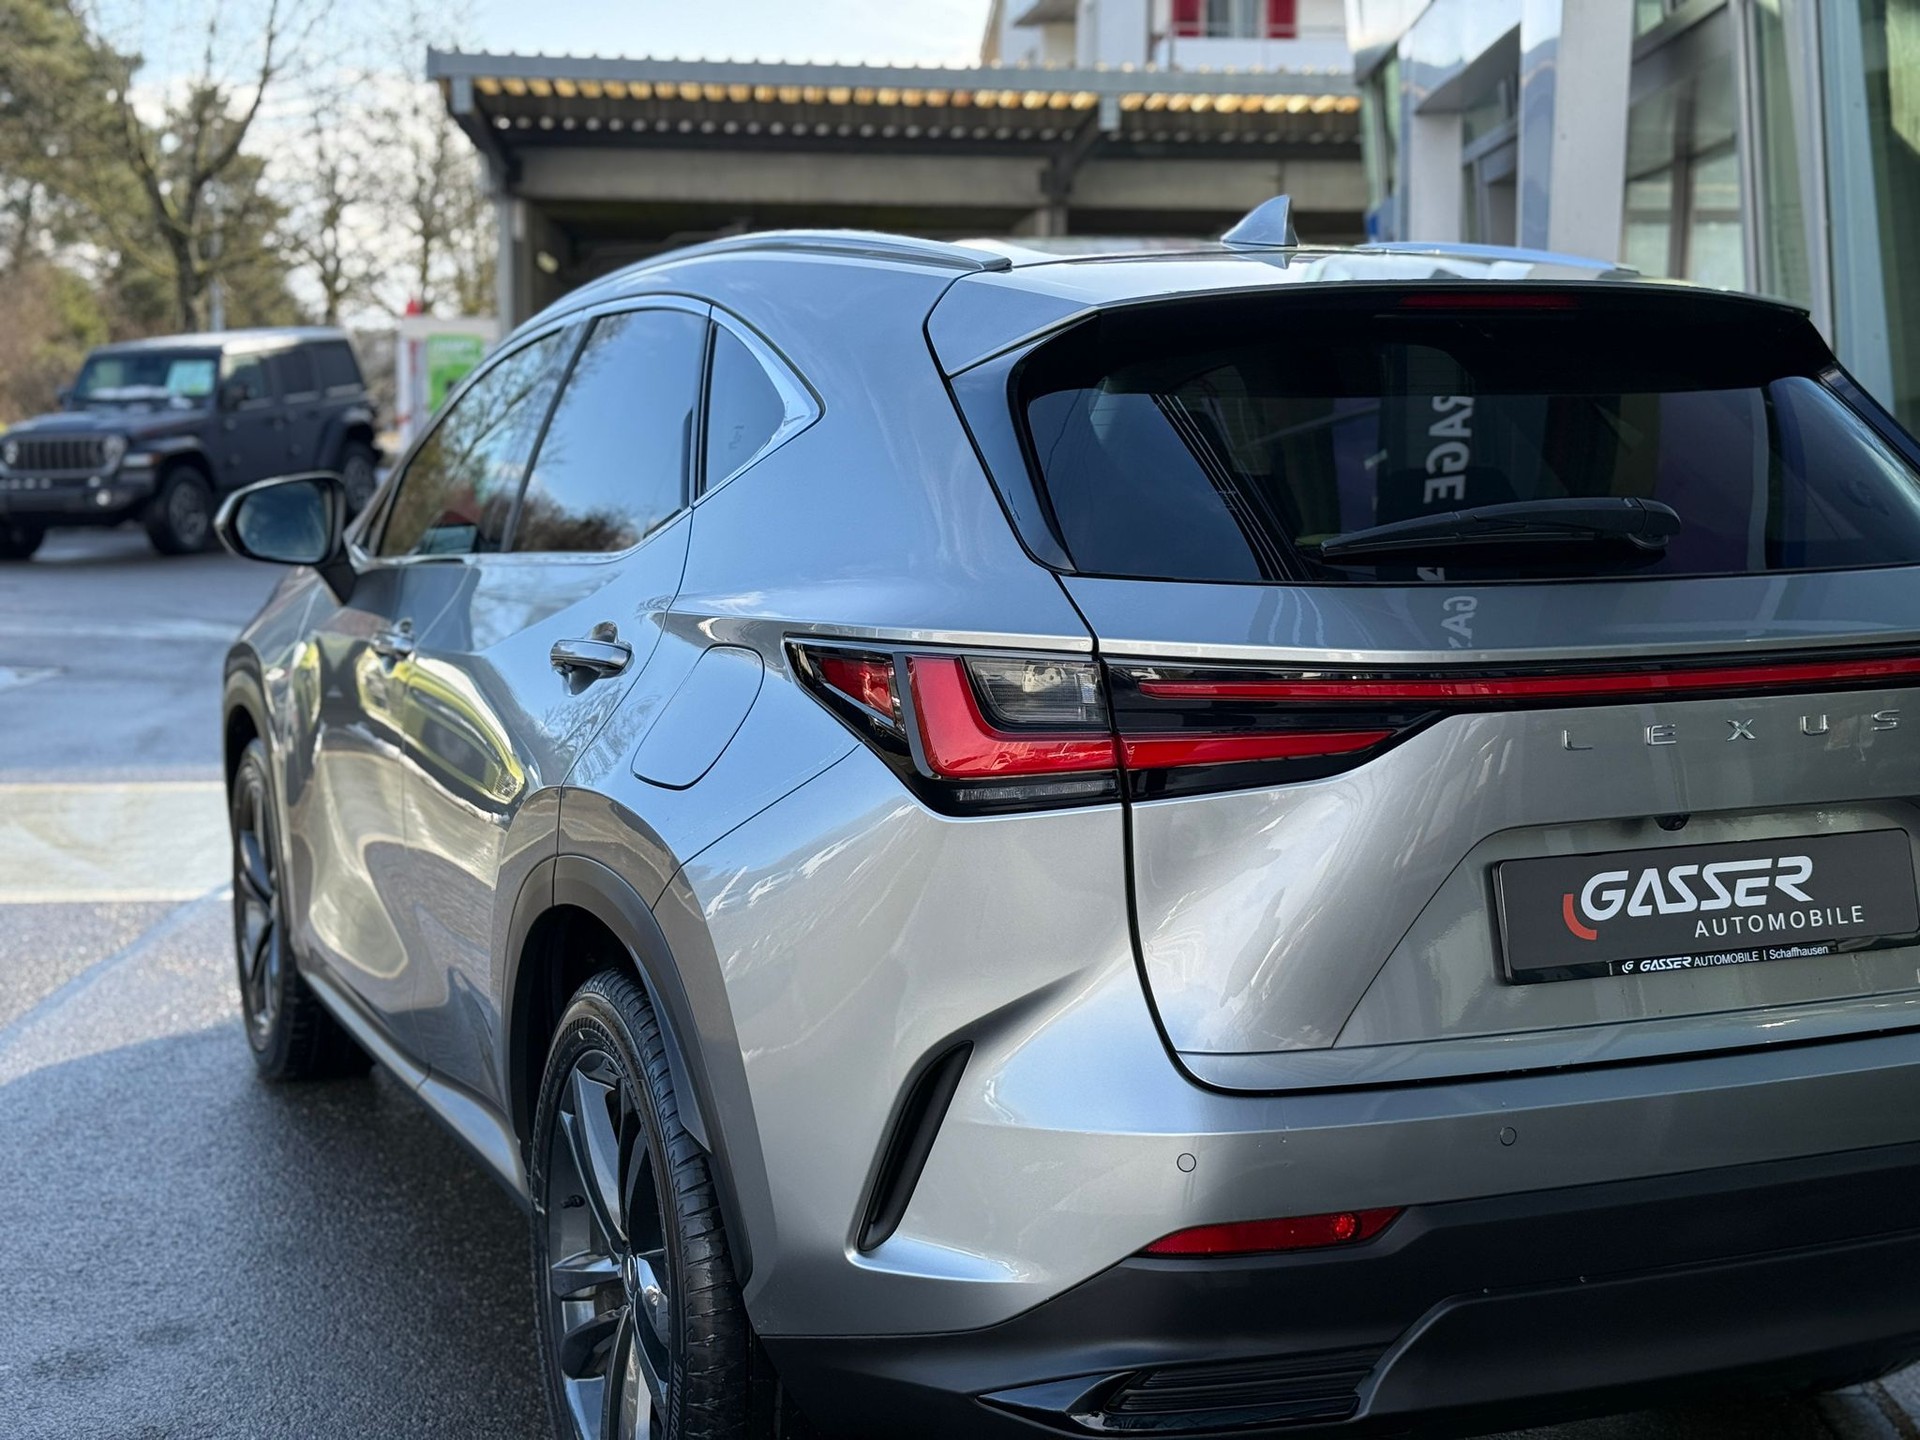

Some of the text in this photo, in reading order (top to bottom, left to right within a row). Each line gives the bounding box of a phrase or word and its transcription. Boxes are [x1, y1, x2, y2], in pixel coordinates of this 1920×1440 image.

[1562, 709, 1900, 751] LEXUS
[1580, 855, 1814, 922] GASSER
[1694, 904, 1865, 939] AUTOMOBILE
[1640, 956, 1692, 972] GASSER
[1694, 950, 1760, 967] AUTOMOBILE
[1769, 945, 1829, 960] Schaffhausen
